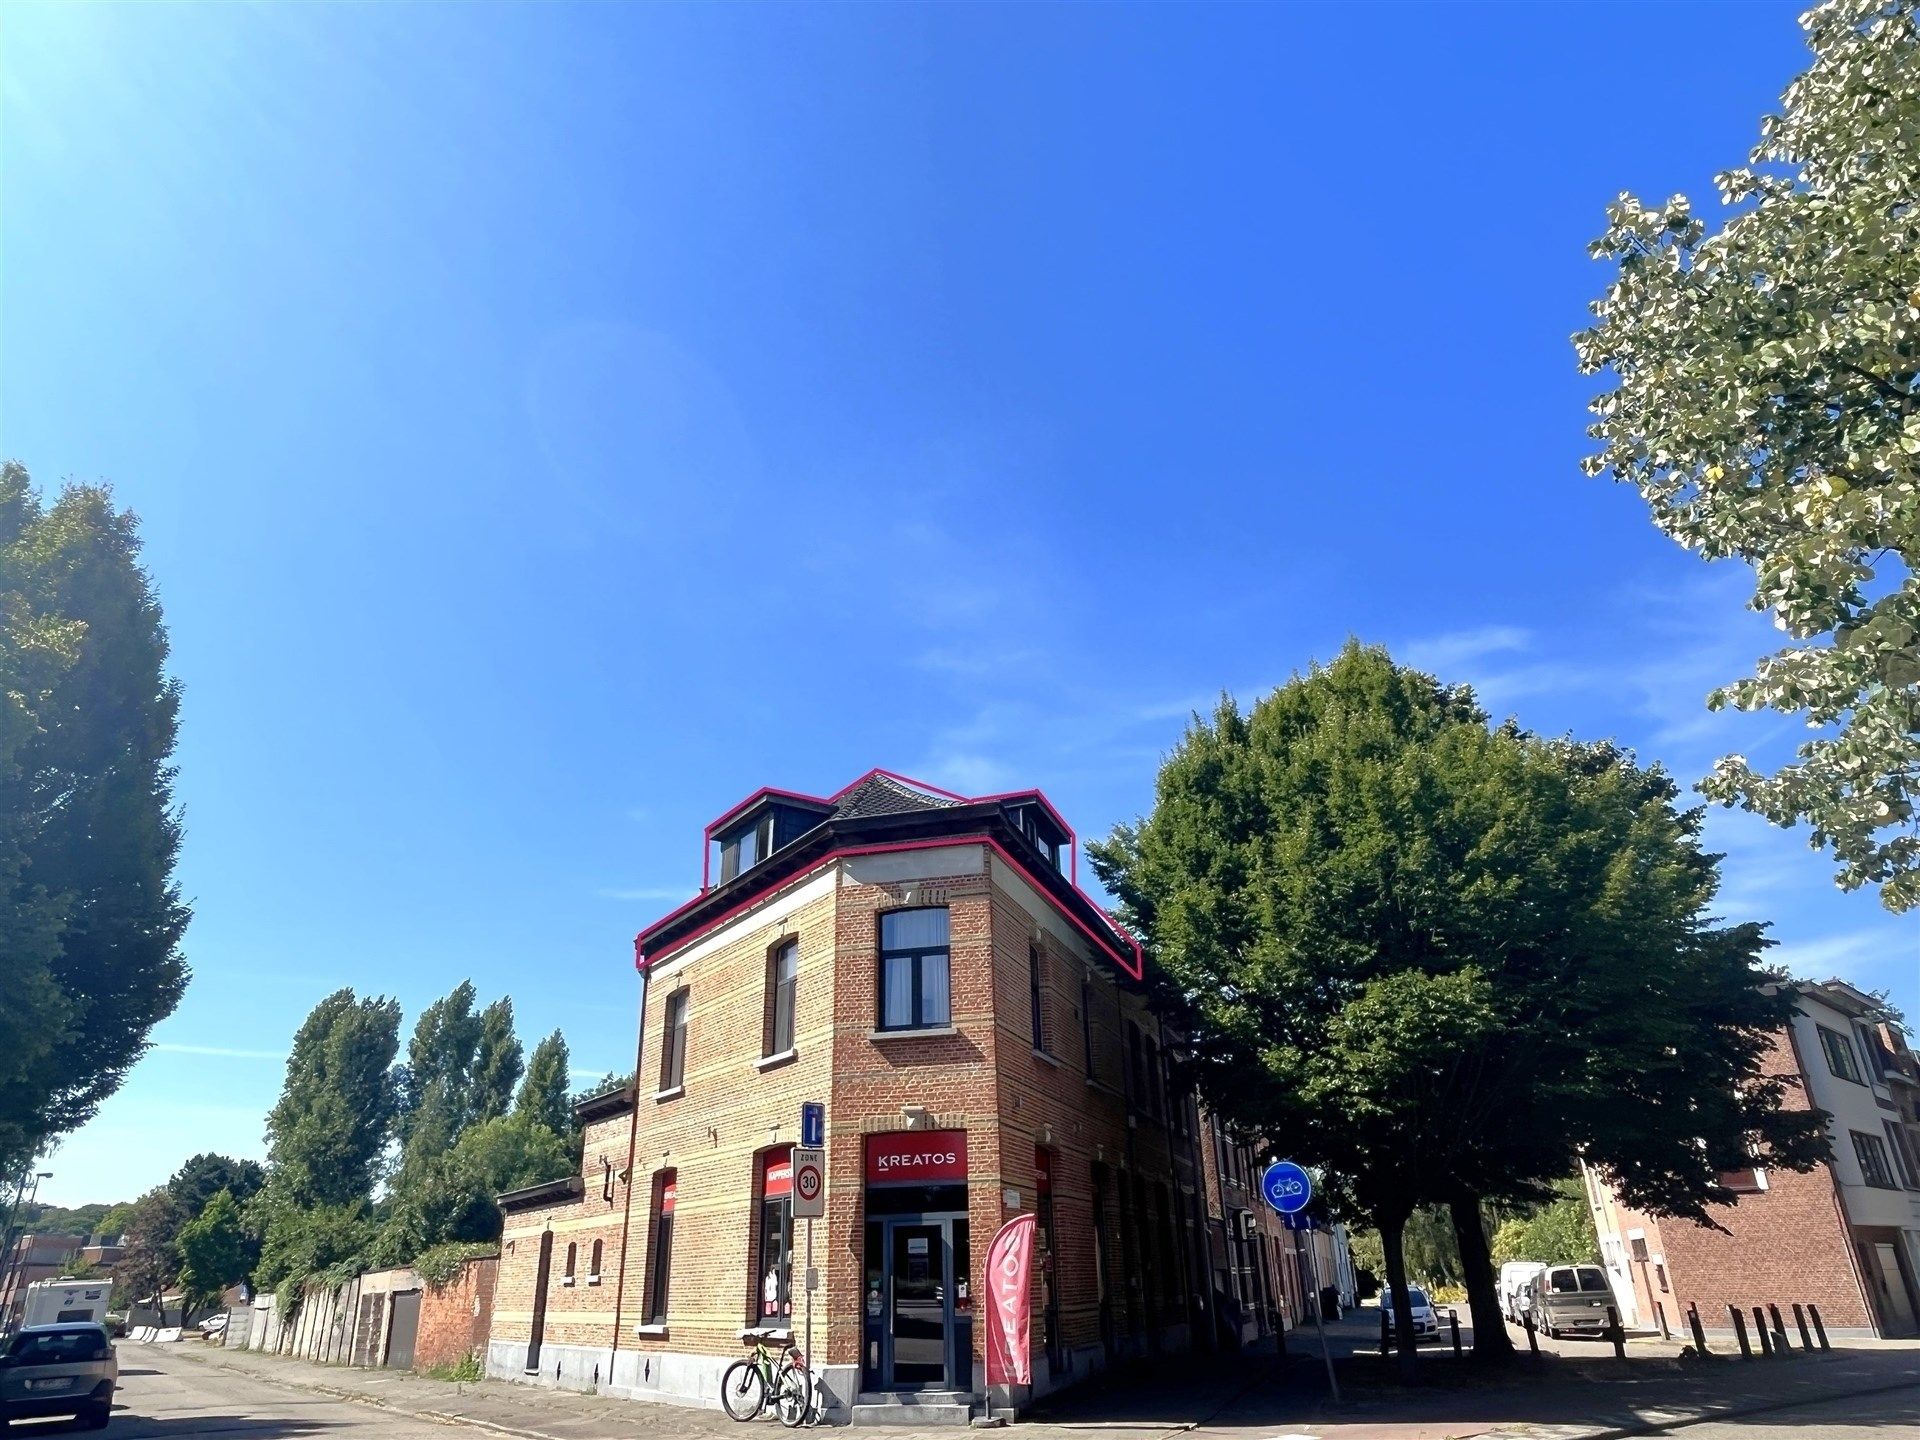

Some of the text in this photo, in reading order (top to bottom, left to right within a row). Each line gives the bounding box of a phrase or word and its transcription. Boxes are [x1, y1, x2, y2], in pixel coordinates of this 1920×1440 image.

[800, 1154, 818, 1162] ZONE
[878, 1152, 957, 1169] KREATOS
[802, 1176, 816, 1189] 30
